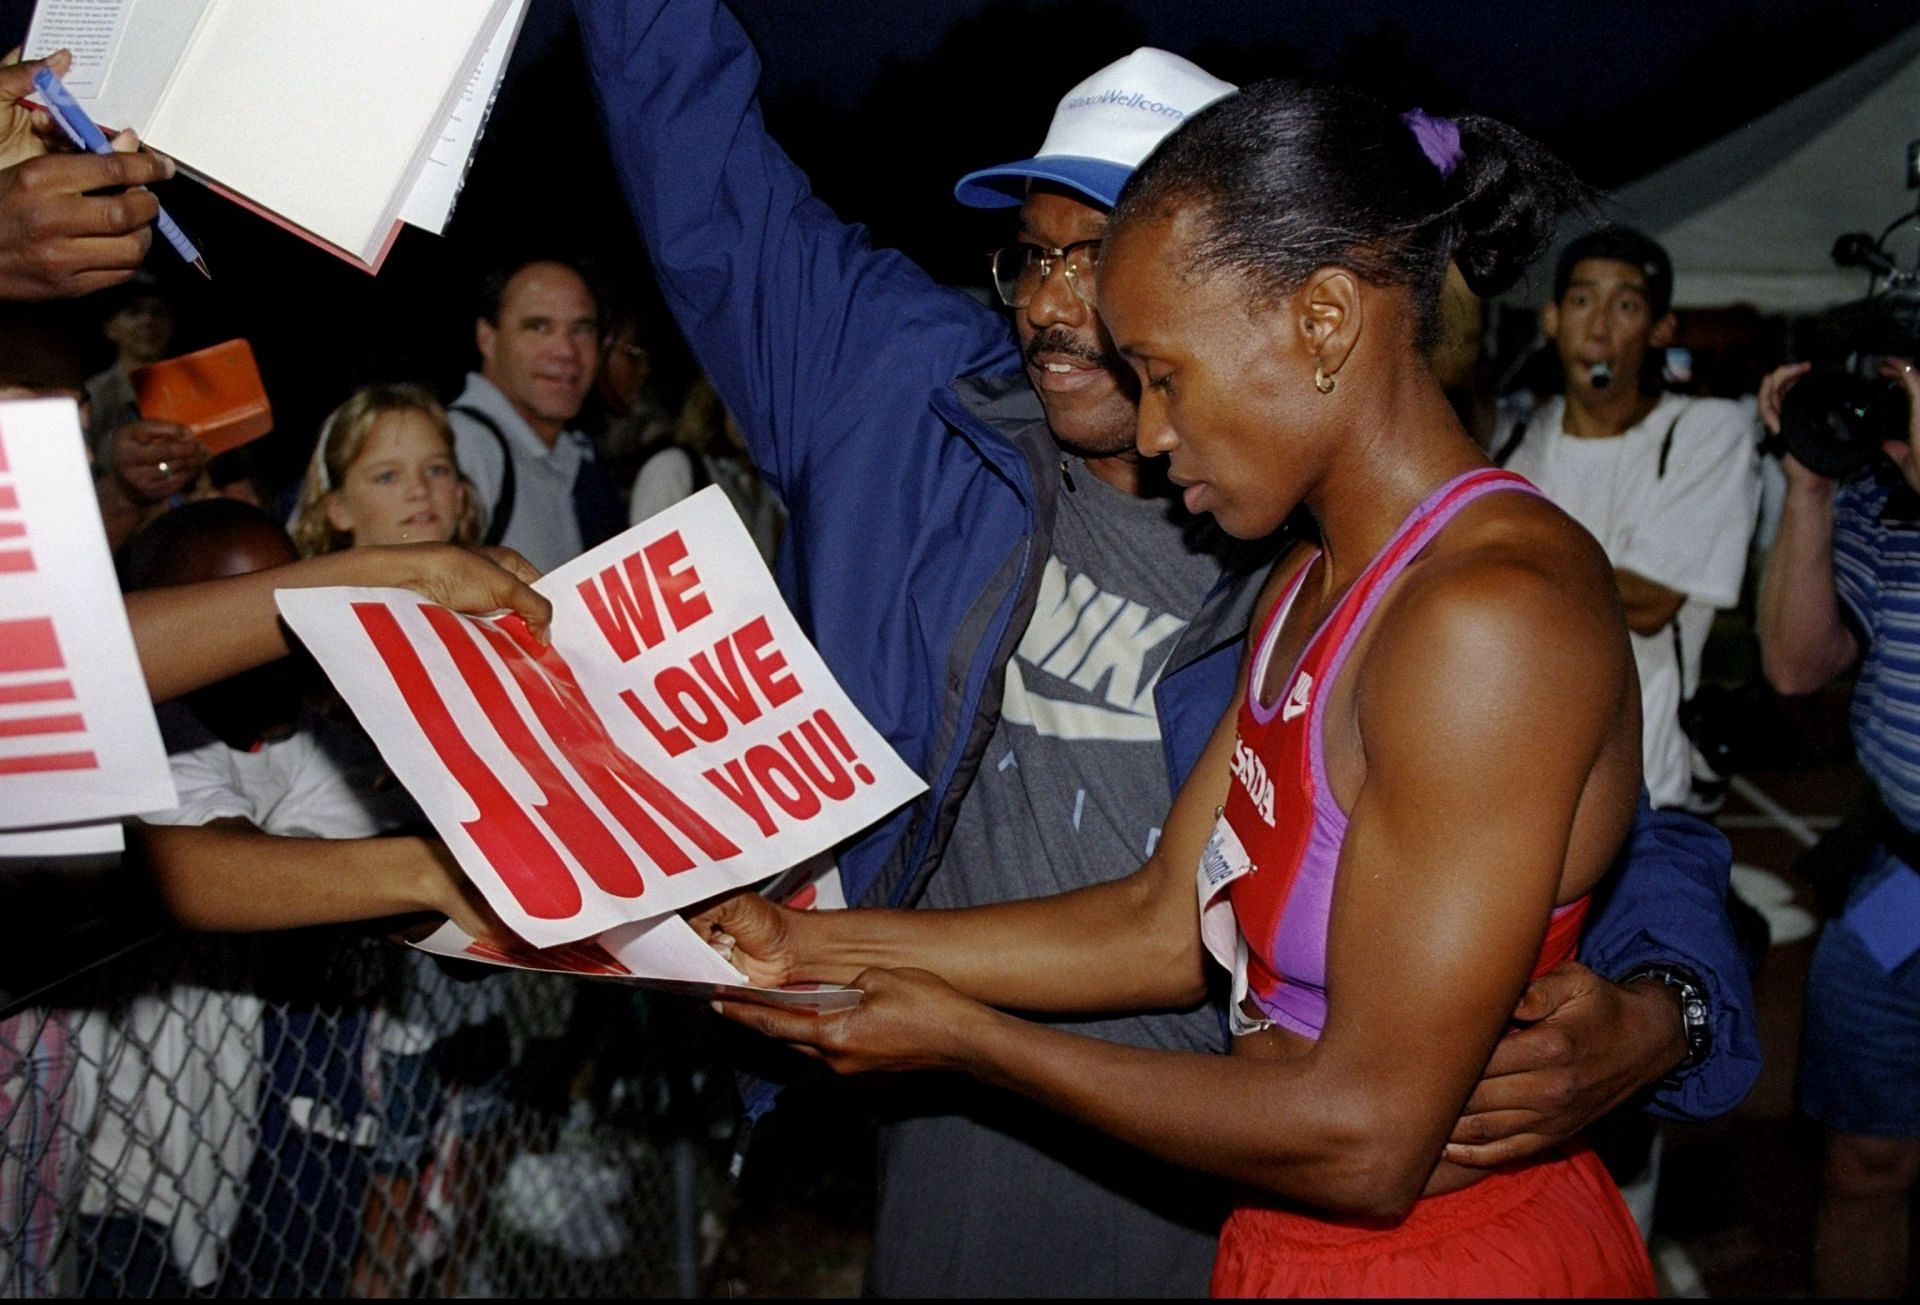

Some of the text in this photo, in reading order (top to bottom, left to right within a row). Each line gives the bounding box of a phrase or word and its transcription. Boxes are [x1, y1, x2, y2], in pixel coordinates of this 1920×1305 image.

[577, 531, 713, 663] WE
[1017, 554, 1190, 709] NIK
[619, 615, 803, 758] LOVE
[703, 708, 876, 838] YOU!
